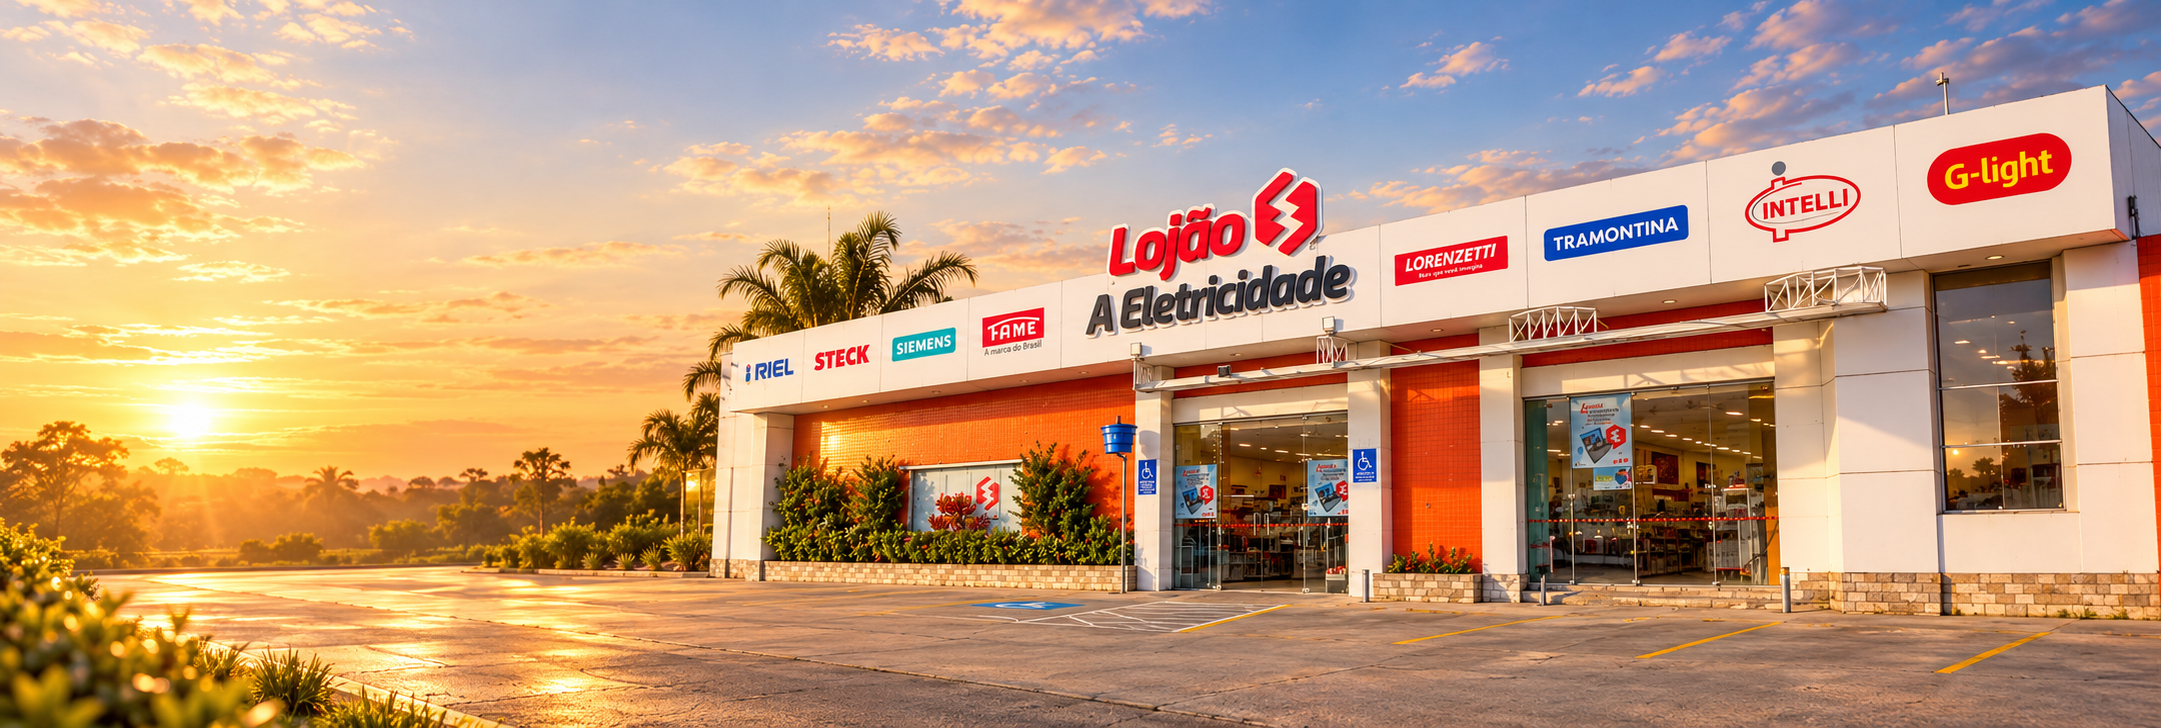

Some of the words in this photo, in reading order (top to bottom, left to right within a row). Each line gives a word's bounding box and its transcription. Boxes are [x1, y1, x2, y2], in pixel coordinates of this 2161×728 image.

[1944, 149, 2054, 190] G-light
[1763, 188, 1849, 220] INTELLI
[1108, 207, 1246, 281] Lojão
[1553, 216, 1679, 251] TRAMONTINA
[1405, 243, 1497, 272] LORENZETTI
[1086, 293, 1114, 336] A
[1120, 255, 1349, 329] Eletricidade
[987, 316, 1040, 341] FAME
[814, 344, 870, 371] STECK
[896, 334, 952, 355] SIEMENS
[984, 348, 990, 356] A
[990, 347, 1011, 355] marca
[1012, 343, 1022, 352] do
[1023, 340, 1042, 350] Brasil
[754, 358, 794, 381] RIEL
